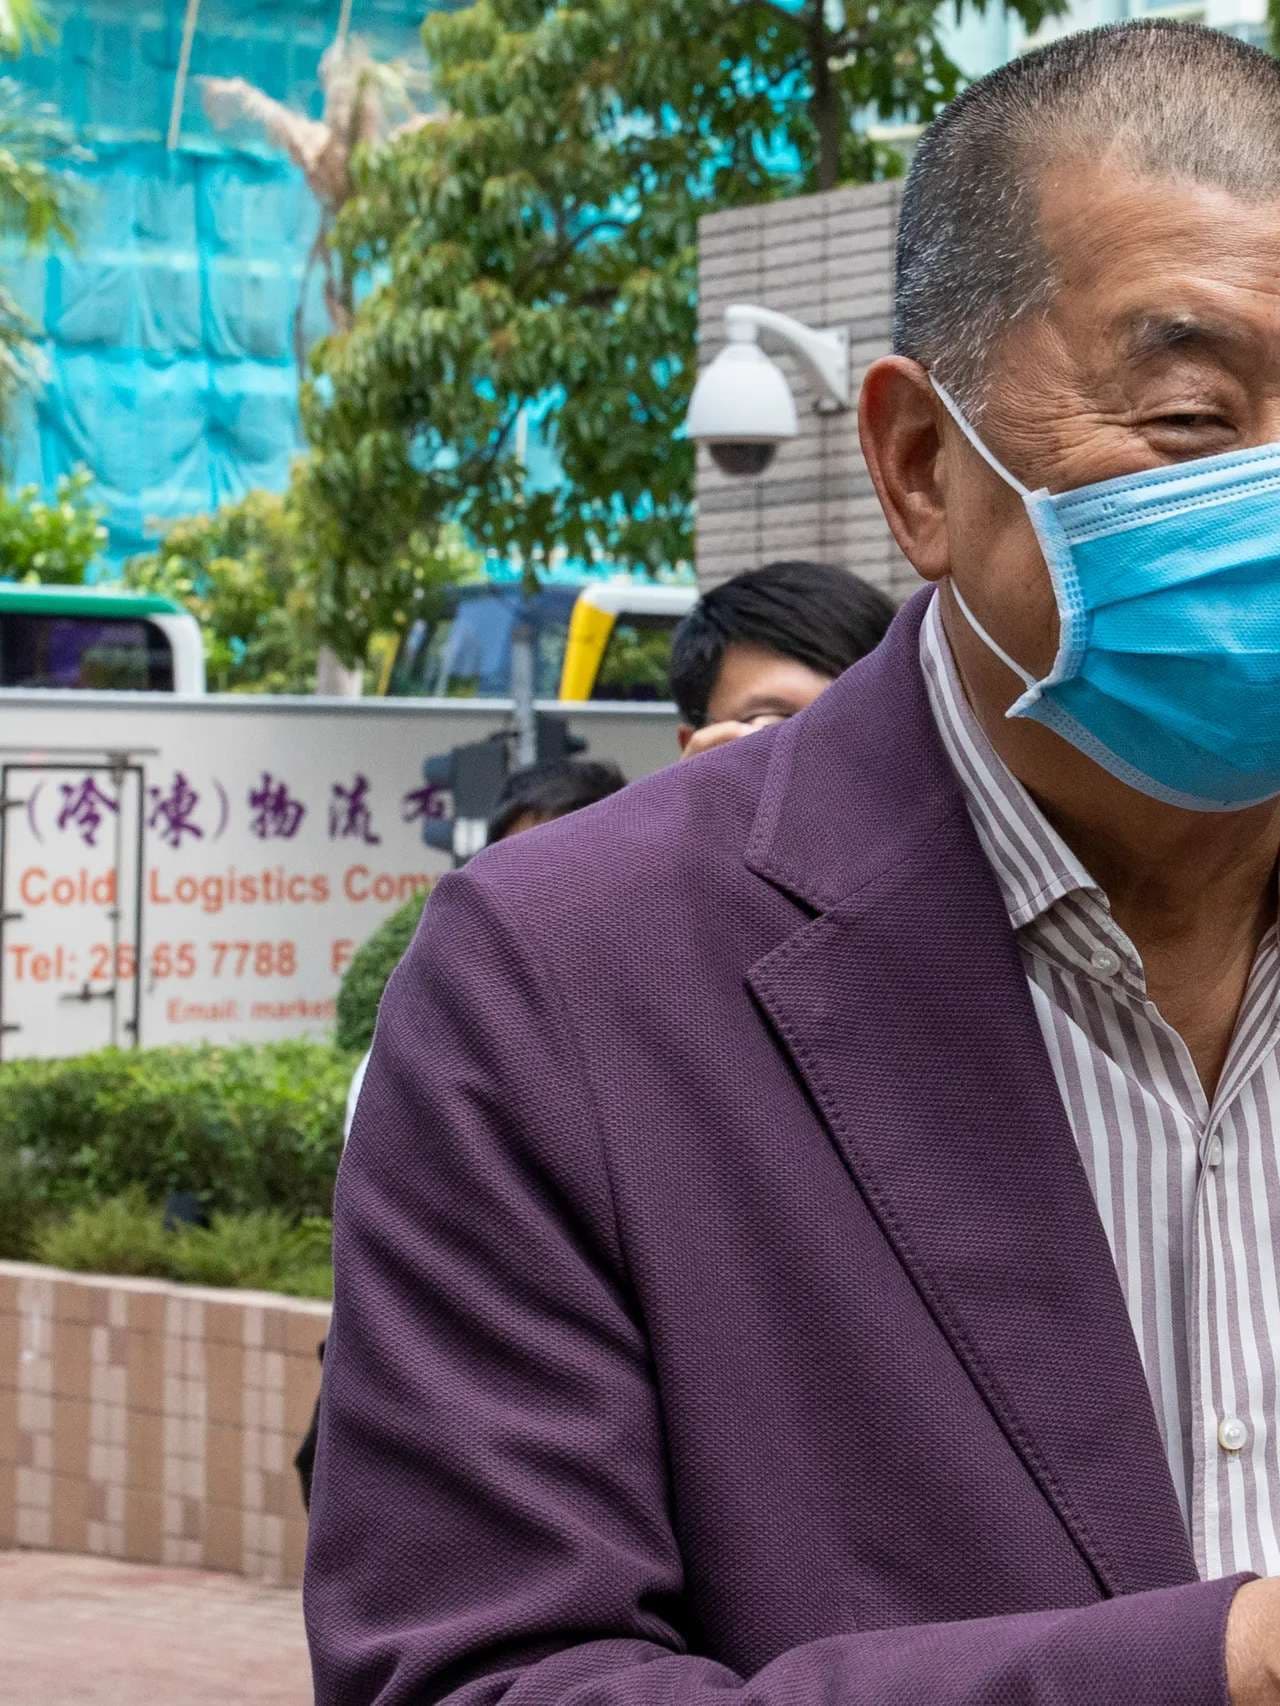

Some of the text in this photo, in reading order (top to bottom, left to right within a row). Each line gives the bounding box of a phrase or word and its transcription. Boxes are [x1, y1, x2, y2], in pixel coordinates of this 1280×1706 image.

[19, 866, 117, 907] Cold
[149, 865, 331, 914] Logistics
[9, 943, 78, 983] Tel:
[210, 940, 298, 978] 7788
